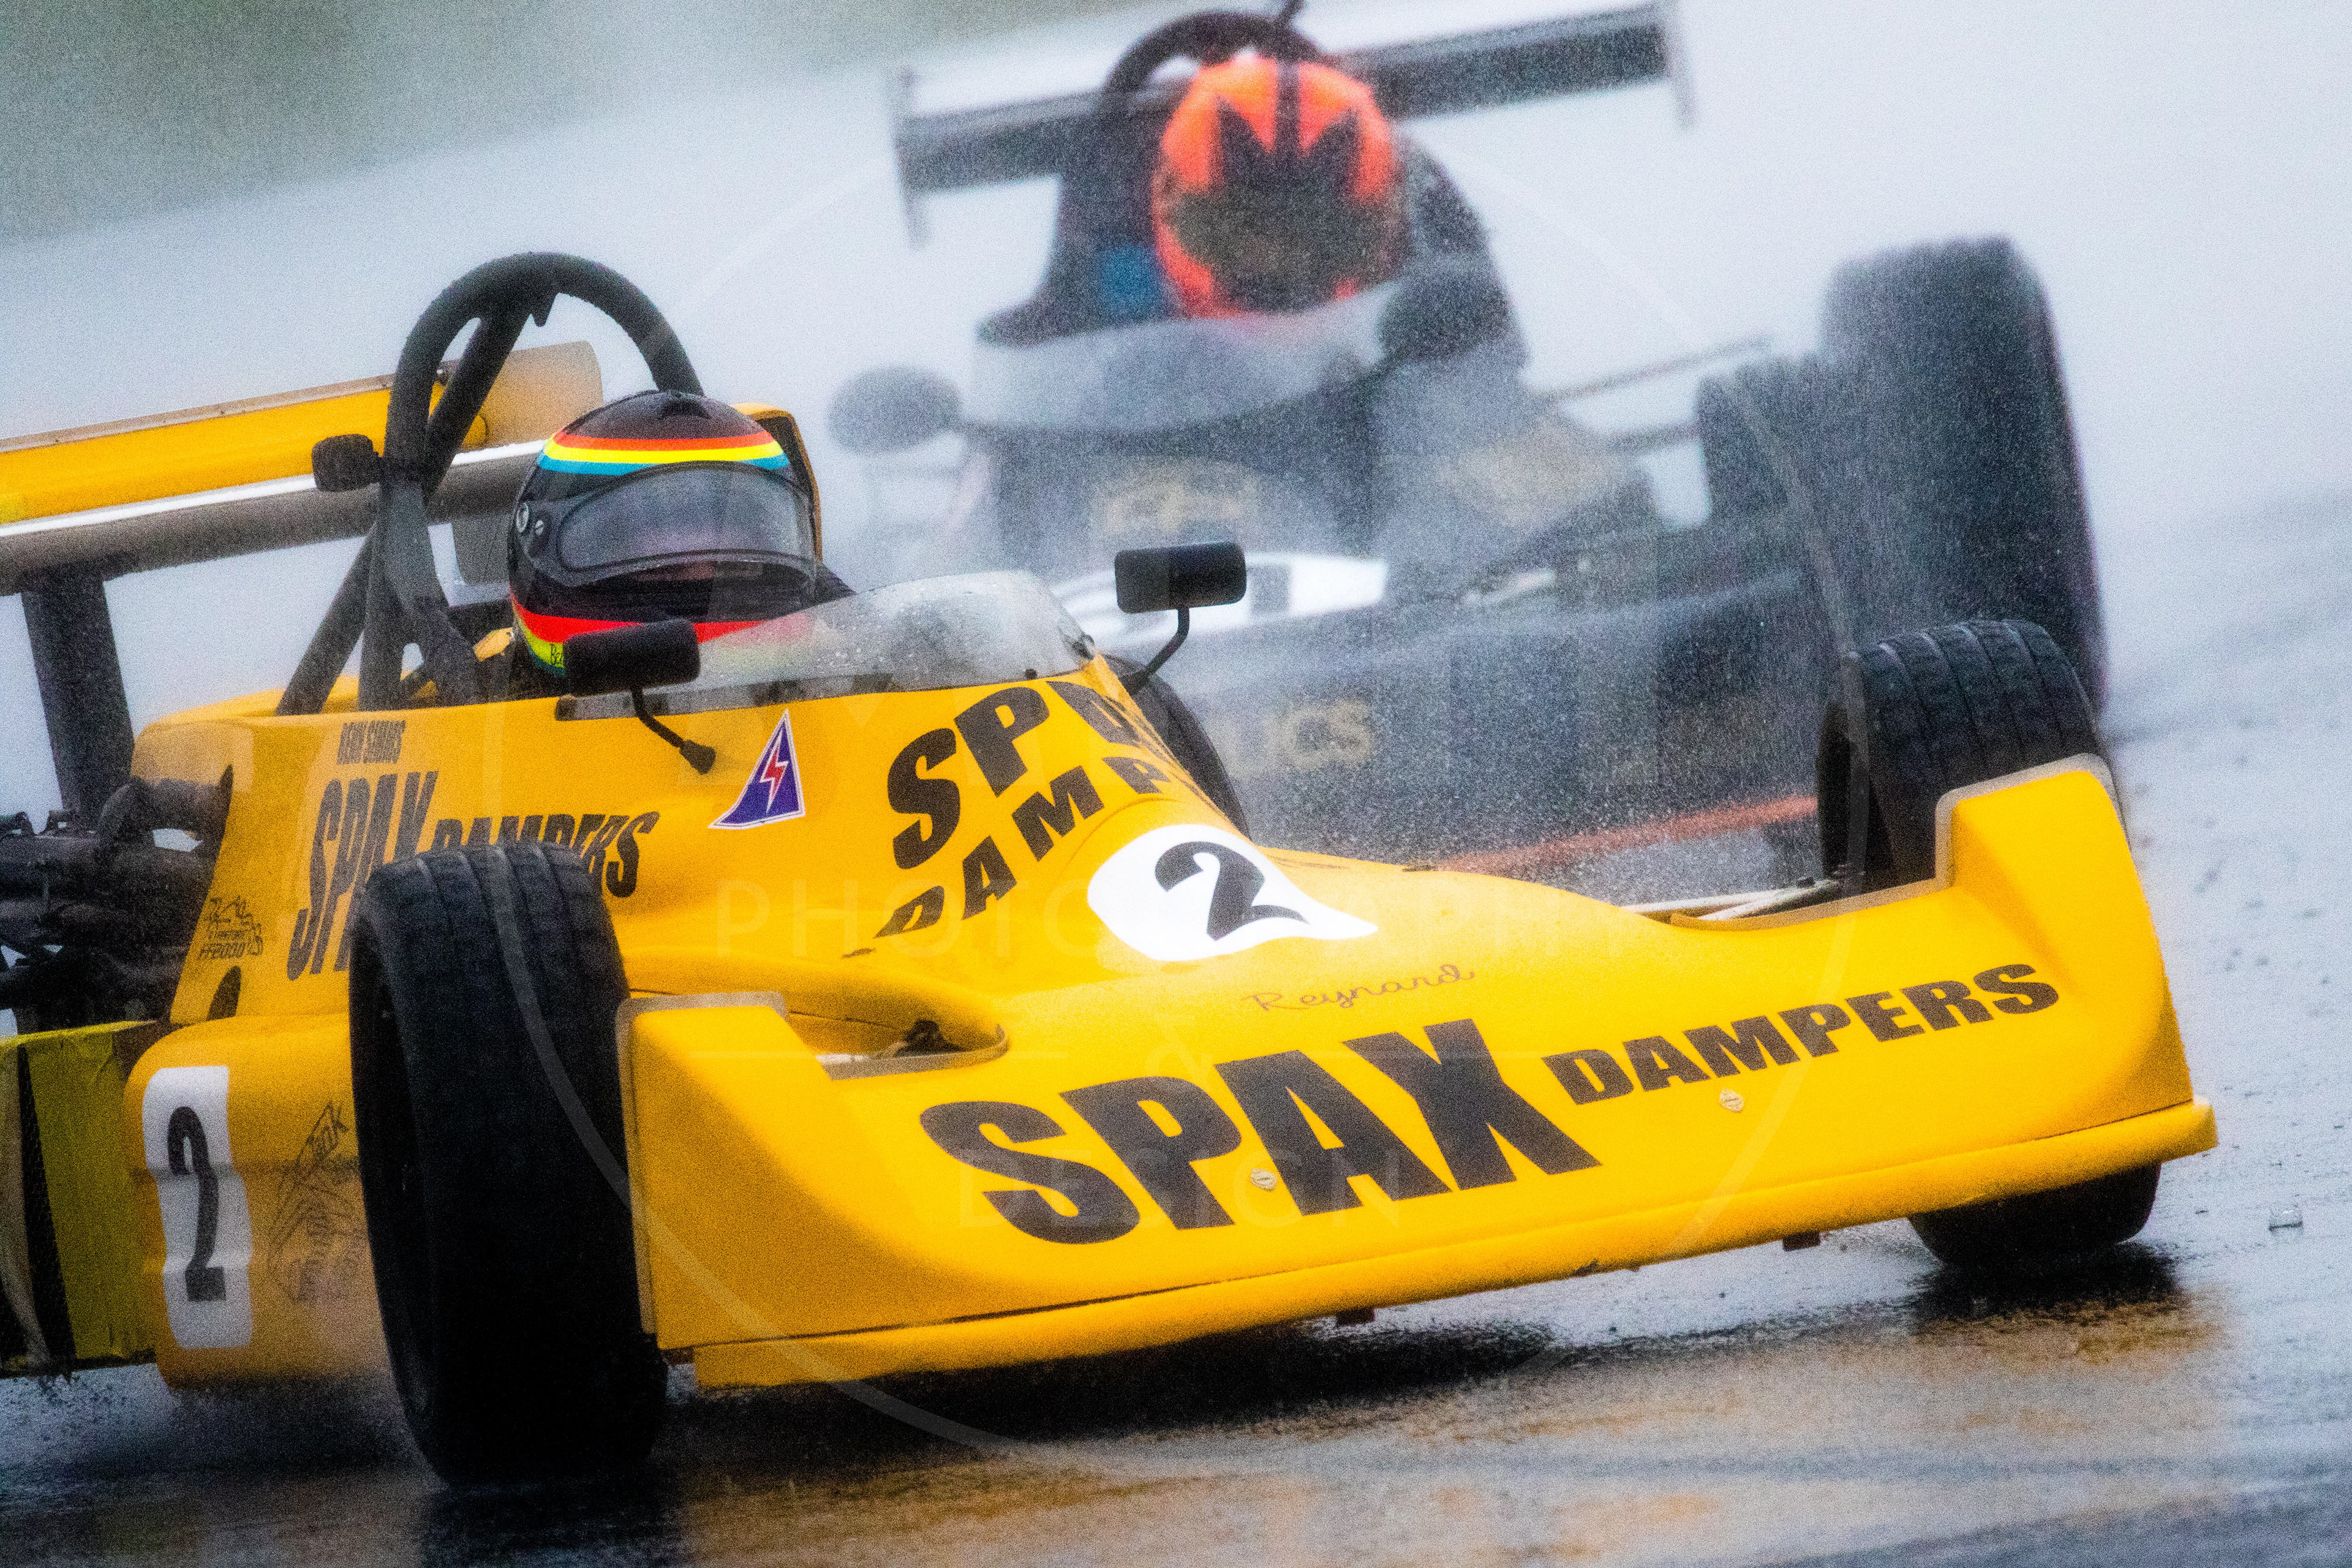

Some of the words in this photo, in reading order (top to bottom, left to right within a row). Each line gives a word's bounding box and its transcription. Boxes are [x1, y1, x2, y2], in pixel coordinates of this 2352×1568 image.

[886, 680, 1164, 869] SPA
[1154, 840, 1310, 941] 2
[1238, 963, 1476, 1014] Reynard
[919, 1018, 1604, 1245] SPAX
[1541, 963, 2060, 1105] DAMPERS
[167, 1106, 227, 1302] 2
